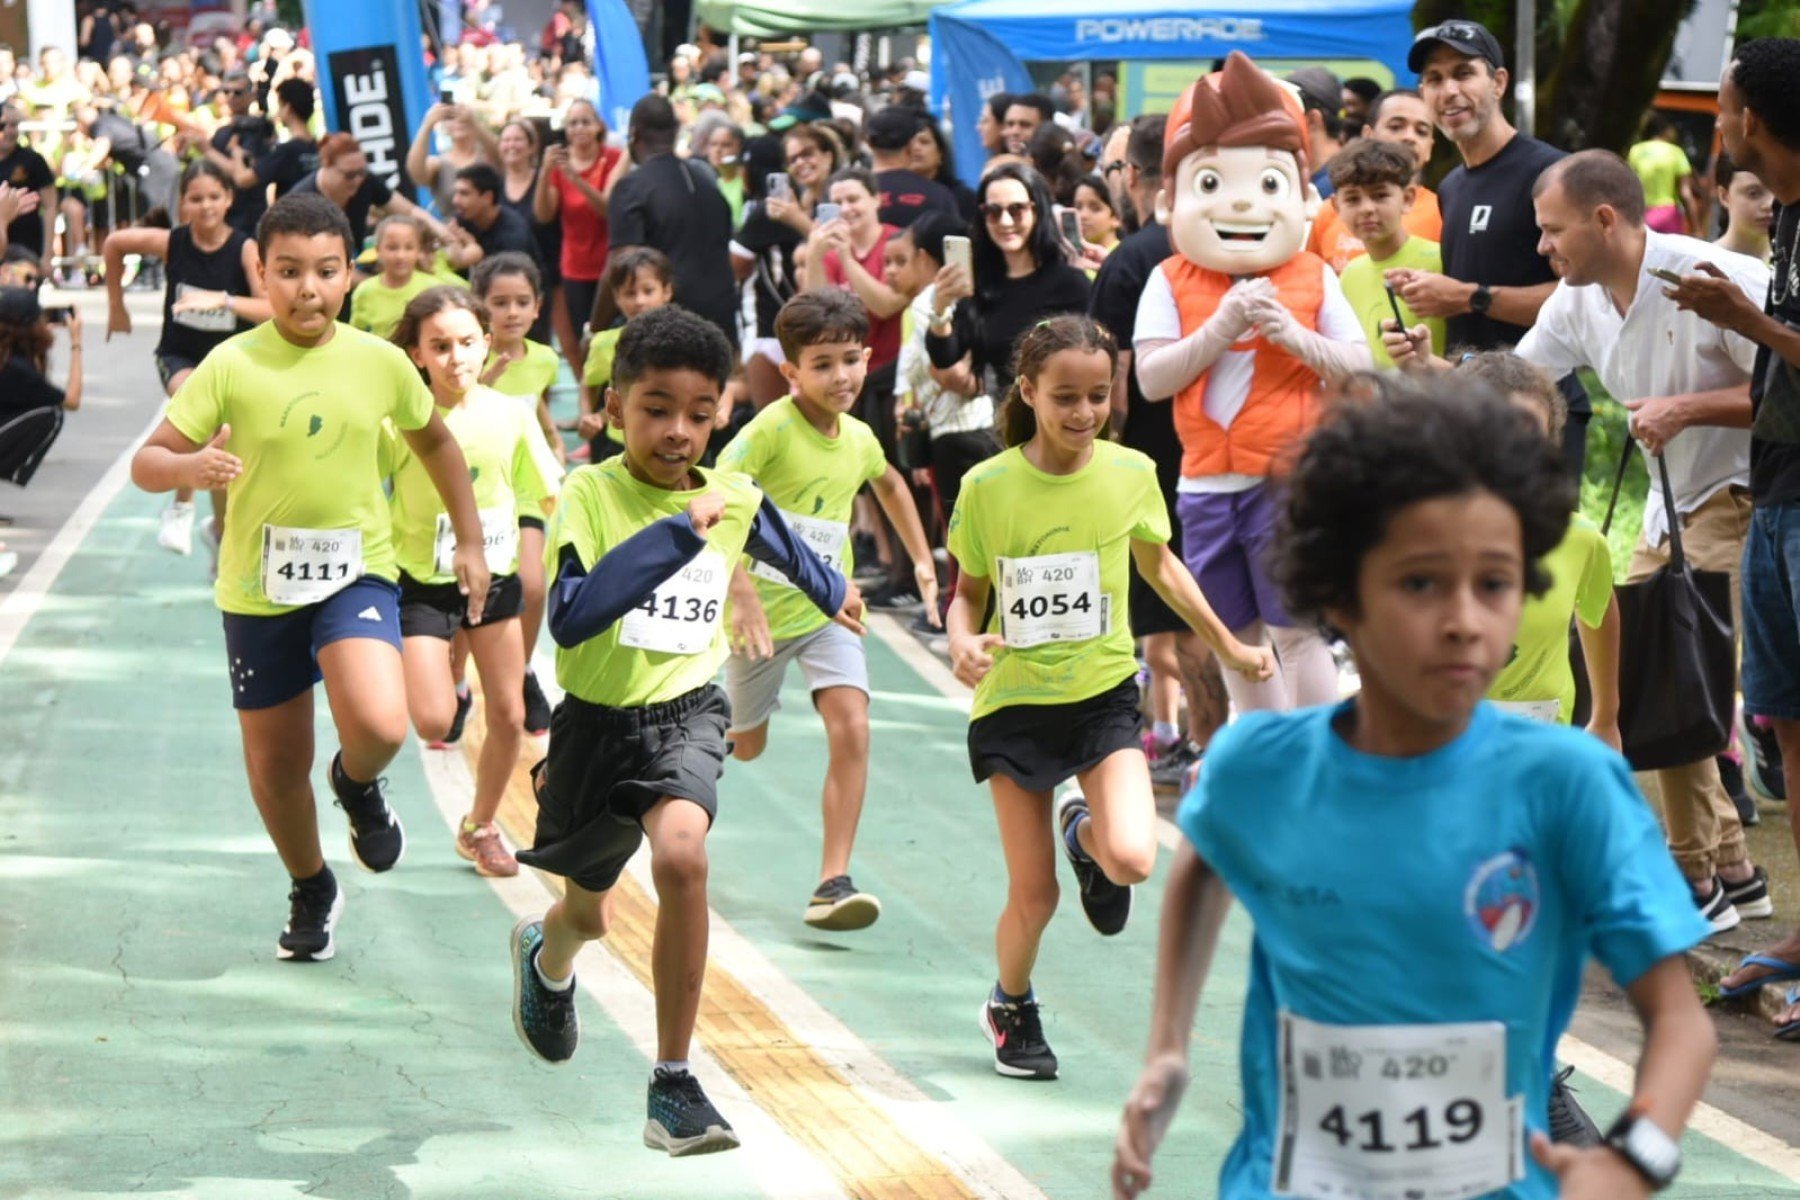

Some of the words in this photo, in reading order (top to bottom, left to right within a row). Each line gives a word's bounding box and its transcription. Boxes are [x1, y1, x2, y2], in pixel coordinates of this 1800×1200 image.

[1075, 17, 1264, 43] POWERADE
[343, 69, 401, 192] ADE
[312, 541, 343, 553] 420
[277, 561, 349, 581] 4111
[682, 567, 713, 584] 420
[1042, 566, 1078, 582] 420
[636, 591, 718, 624] 4136
[1010, 591, 1091, 620] 4054
[1381, 1054, 1457, 1080] 420
[1319, 1098, 1484, 1152] 4119
